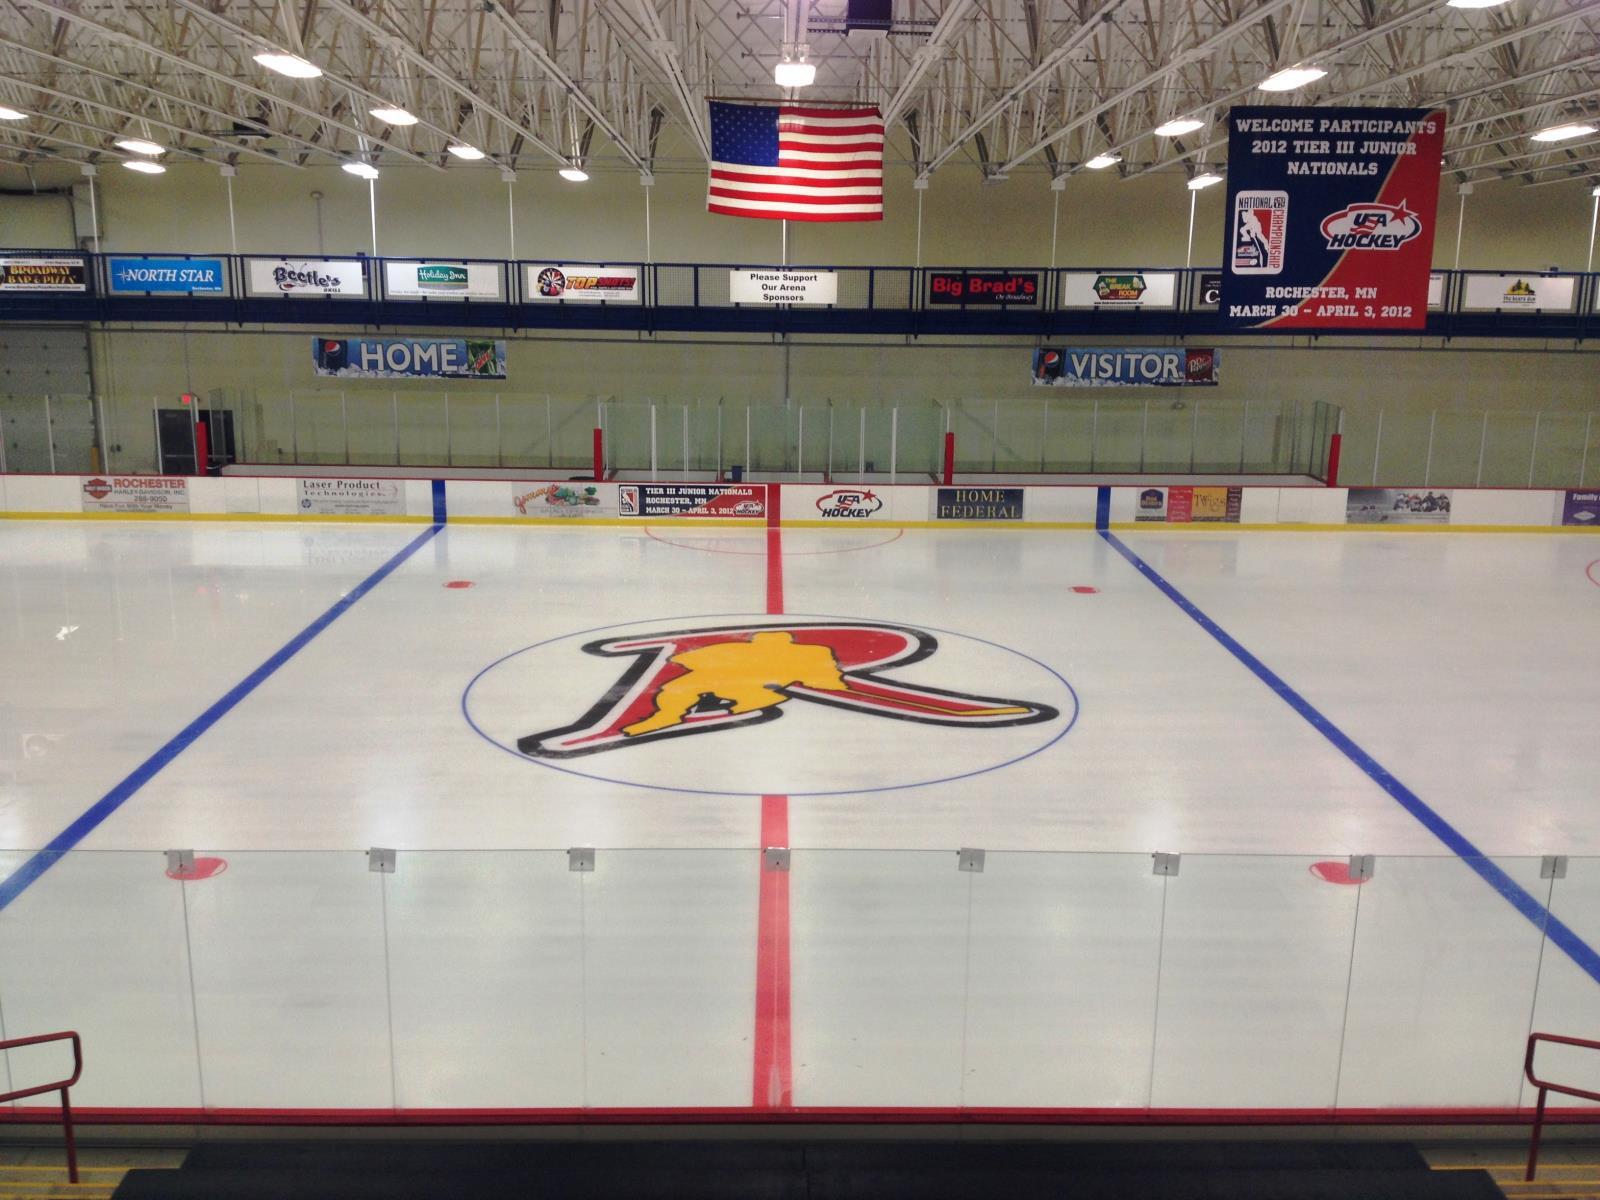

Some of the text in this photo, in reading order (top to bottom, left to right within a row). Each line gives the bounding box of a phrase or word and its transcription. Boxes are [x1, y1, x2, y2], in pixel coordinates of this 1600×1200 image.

[1236, 119, 1437, 135] WELCOME PARTICIPANTS
[1252, 141, 1417, 156] 2012 TIER III JUNIOR
[1287, 162, 1379, 176] NATIONALS
[1239, 197, 1272, 209] NATIONAL
[1353, 213, 1387, 228] USA
[1269, 210, 1285, 269] CHAMPIONSHIP
[1328, 233, 1406, 250] HOCKEY
[10, 266, 70, 275] BROADWAY
[127, 269, 214, 282] NORTH STAR
[419, 270, 466, 281] Holiday Inn
[8, 275, 32, 284] BAR
[43, 275, 76, 284] PIZZA
[273, 267, 341, 288] Beetle's
[566, 276, 598, 289] TOP
[750, 273, 818, 282] Please Support
[933, 277, 1035, 296] Big Brad's
[1119, 289, 1138, 297] ROOM
[763, 294, 804, 302] Sponsors
[1265, 287, 1378, 300] ROCHESTER, MN
[1229, 304, 1276, 317] MARCH
[1281, 305, 1299, 317] 30
[1316, 306, 1358, 318] APRIL
[1364, 306, 1376, 319] 3,
[1381, 306, 1412, 318] 2012
[360, 343, 457, 372] HOME
[1071, 353, 1180, 379] VISITOR
[114, 479, 186, 489] ROCHESTER
[303, 480, 380, 489] Laser Product
[709, 488, 753, 496] NATIONALS
[956, 490, 1005, 503] HOME
[646, 497, 692, 505] ROCHESTER,
[837, 495, 860, 504] USA
[822, 508, 874, 518] HOCKEY
[941, 505, 1021, 518] FEDERAL
